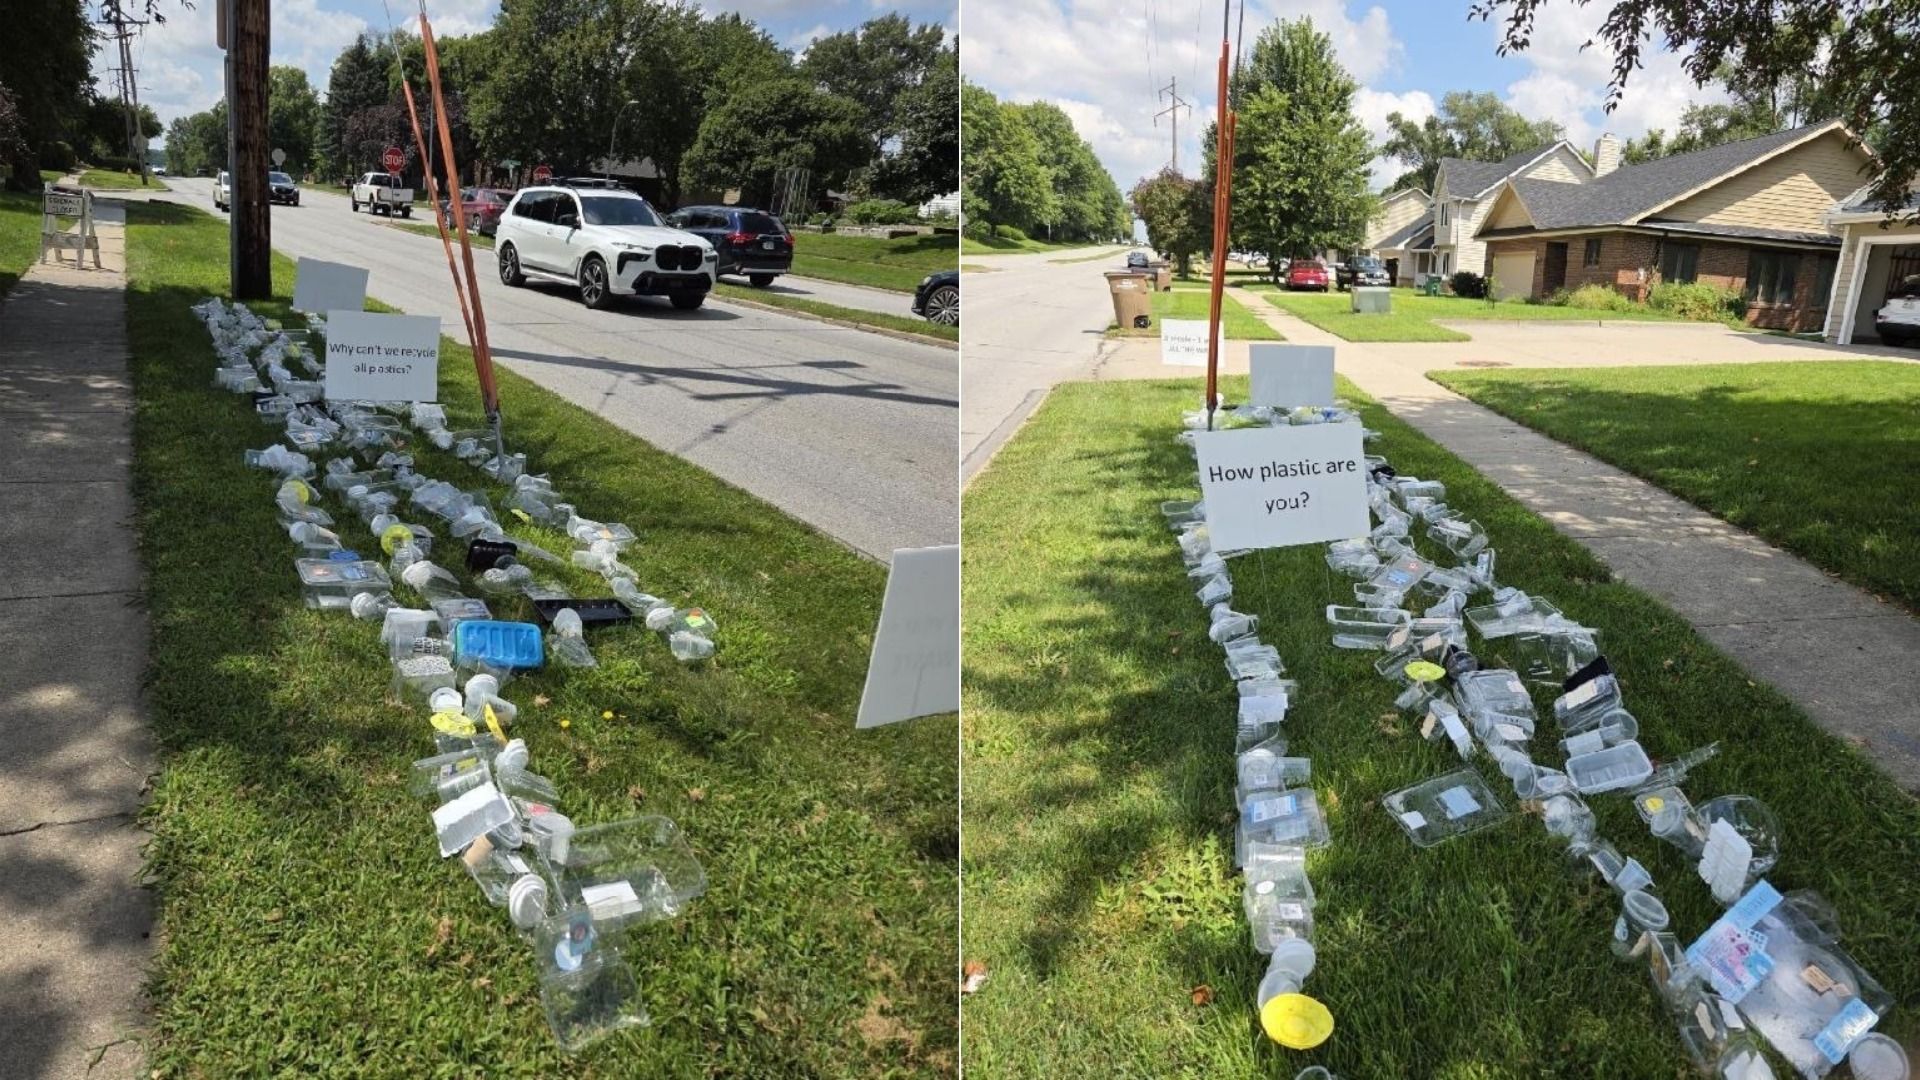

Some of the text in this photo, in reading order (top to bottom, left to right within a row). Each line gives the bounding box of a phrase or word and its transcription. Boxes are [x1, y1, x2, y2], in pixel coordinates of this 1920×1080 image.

[385, 154, 402, 165] STOP
[329, 343, 354, 356] Why
[356, 344, 381, 355] can't
[384, 347, 399, 356] we
[354, 362, 412, 375] all pastics?
[1209, 458, 1357, 483] How plastic are
[1264, 491, 1310, 514] you?
